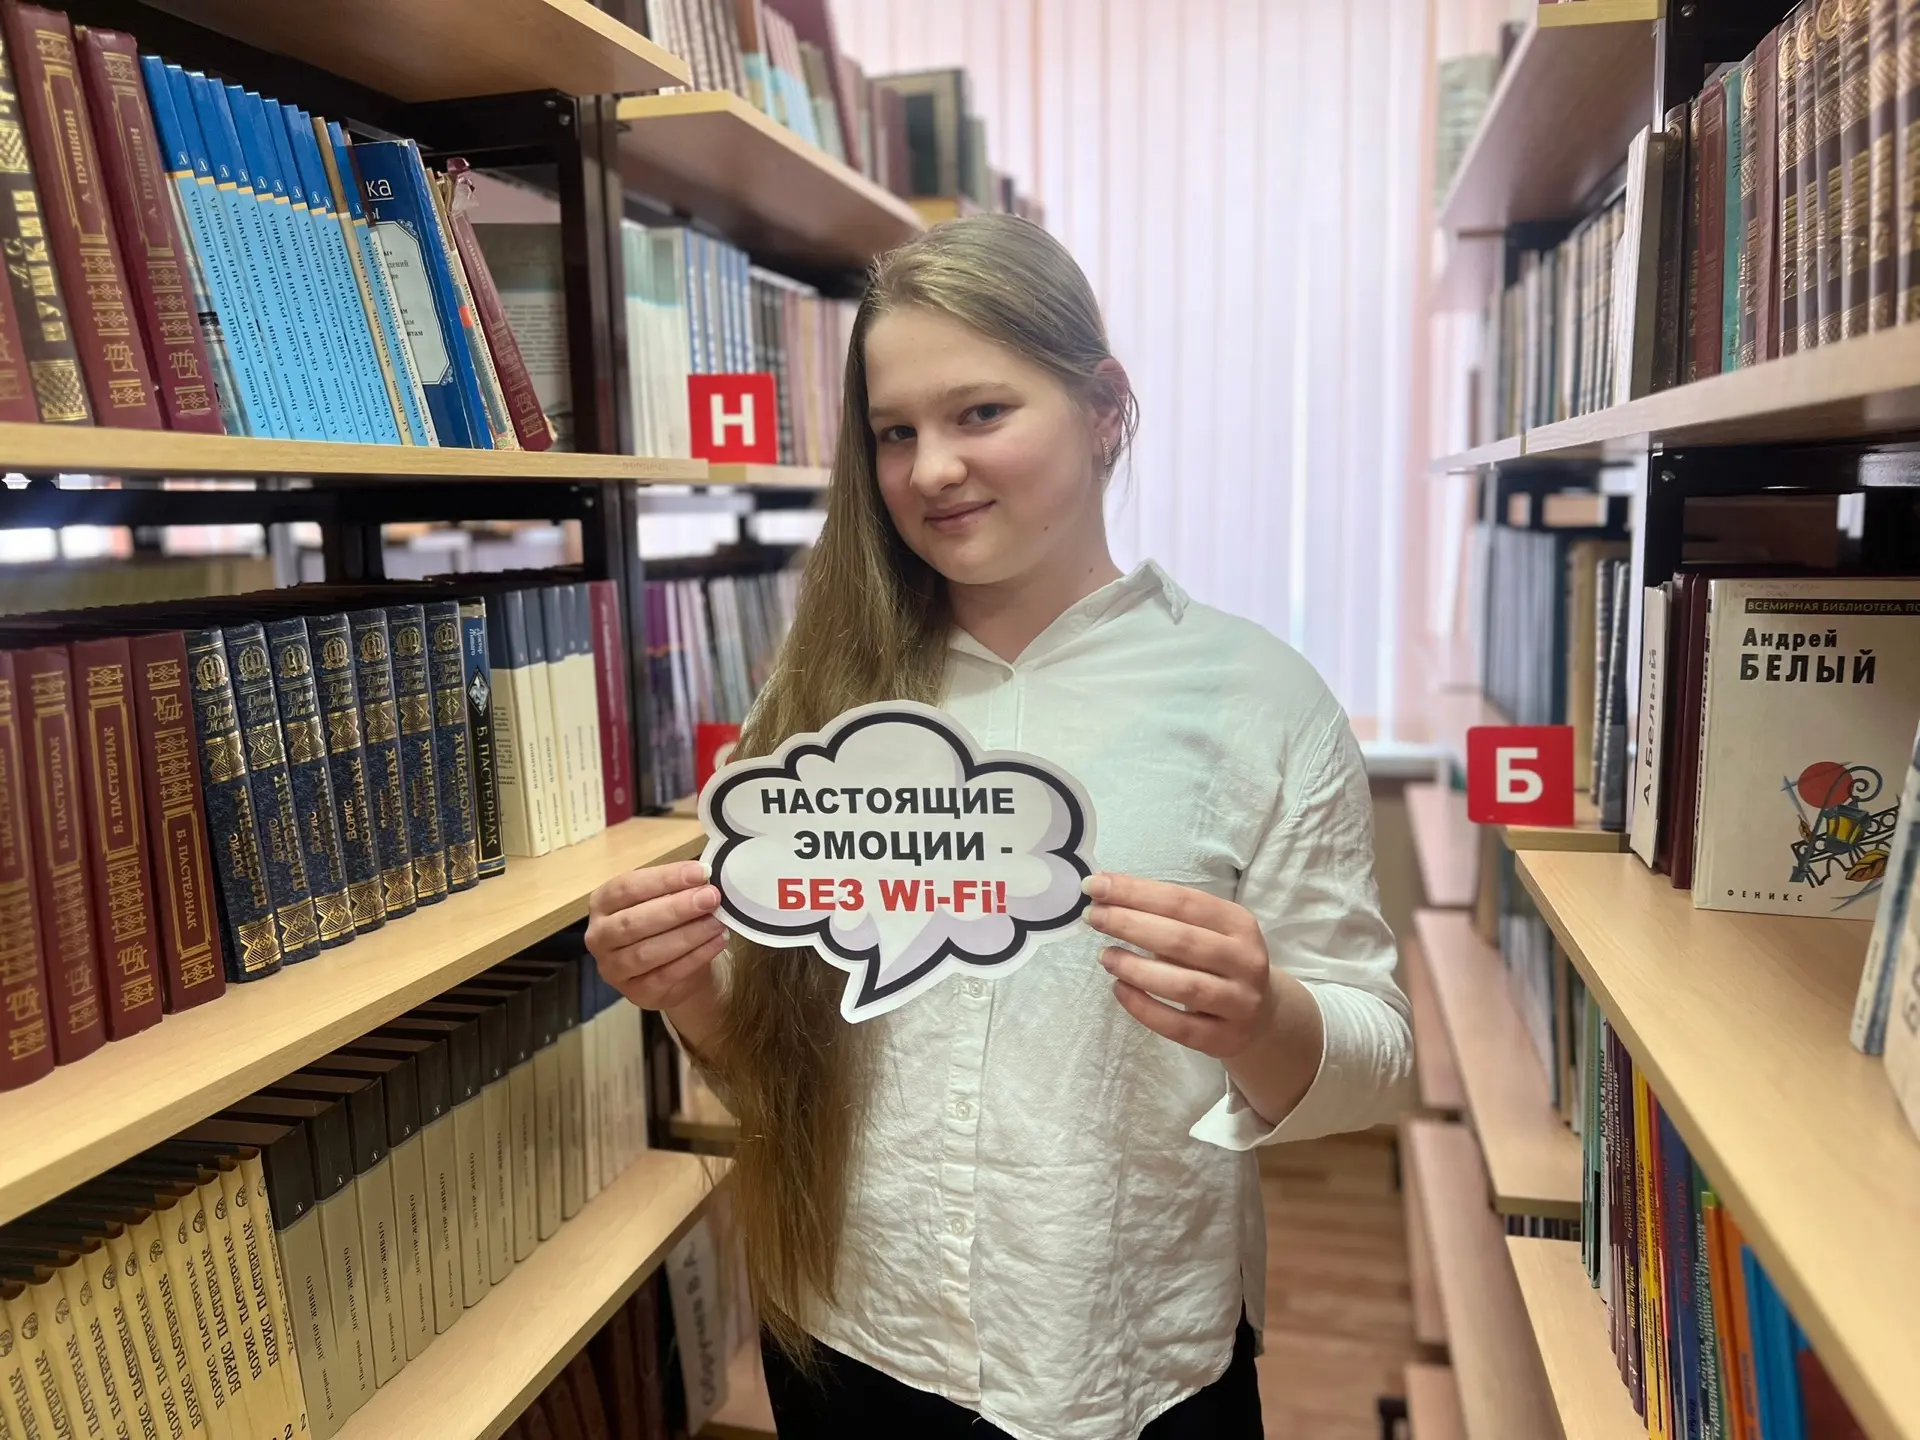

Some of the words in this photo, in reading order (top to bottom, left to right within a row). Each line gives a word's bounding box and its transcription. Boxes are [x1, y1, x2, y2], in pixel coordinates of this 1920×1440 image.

[63, 108, 89, 186] ПУШКИН
[131, 126, 155, 199] ПУШКИН
[190, 191, 212, 250] ЛЮДМИЛА
[210, 197, 231, 255] ЛЮДМИЛА
[232, 203, 252, 260] ЛЮДМИЛА
[250, 206, 271, 263] ЛЮДМИЛА
[268, 213, 289, 268] ЛЮДМИЛА
[12, 189, 68, 342] ПУШКИН
[212, 265, 229, 308] РУСЛАН
[231, 270, 248, 312] РУСЛАН
[252, 274, 269, 316] РУСЛАН
[271, 277, 287, 317] РУСЛАН
[288, 282, 304, 322] РУСЛАН
[228, 316, 245, 360] СКАЗКИ
[247, 322, 263, 363] СКАЗКИ
[268, 325, 283, 366] СКАЗКИ
[285, 327, 301, 366] СКАЗКИ
[302, 331, 317, 370] СКАЗКИ
[244, 367, 259, 405] Пушкин
[263, 370, 277, 408] Пушкин
[283, 373, 297, 409] Пушкин
[301, 373, 314, 410] Пушкин
[317, 377, 330, 413] Пушкин
[710, 393, 756, 446] Н
[1747, 600, 1818, 612] ВСЕМИРНАЯ
[1822, 601, 1901, 613] БИБЛИОТЕКА
[1742, 628, 1838, 651] Андрей
[1740, 648, 1876, 684] БЕЛЫЙ
[477, 726, 489, 741] Б.
[49, 736, 69, 825] ПАСТЕРНАК
[104, 727, 123, 810] ПАСТЕРНАК
[419, 739, 440, 843] ПАСТЕРНАК
[454, 731, 472, 832] ПАСТЕРНАК
[1495, 746, 1544, 804] Б
[344, 799, 357, 841] БОРИС
[386, 747, 407, 854] ПАСТЕРНАК
[479, 744, 497, 847] ПАСТЕРНАК
[760, 787, 1015, 820] НАСТОЯЩИЕ
[113, 813, 124, 834] Б.
[176, 828, 187, 845] Б.
[274, 772, 306, 891] ПАСТЕРНАК
[793, 830, 986, 866] ЭМОЦИИ
[177, 849, 198, 930] ПАСТЕРНАК
[778, 878, 865, 911] БЕЗ
[878, 879, 1007, 915] Wi-Fi!
[1727, 889, 1803, 902] ФЕНИКС
[243, 1218, 266, 1310] ПАСТЕРНАК
[343, 1247, 353, 1289] ЖИВАГО
[378, 1221, 386, 1263] ЖИВАГО
[186, 1256, 211, 1351] ПАСТЕРНАК
[202, 1244, 227, 1338] ПАСТЕРНАК
[224, 1231, 248, 1324] ПАСТЕРНАК
[306, 1275, 316, 1319] ЖИВАГО
[136, 1287, 166, 1384] ПАСТЕРНАК
[159, 1274, 186, 1371] ПАСТЕРНАК
[348, 1294, 358, 1329] ДОКТОР
[113, 1299, 144, 1401] ПАСТЕРНАК
[243, 1327, 261, 1379] БОРИС
[260, 1313, 278, 1366] БОРИС
[312, 1323, 324, 1359] ДОКТОР
[66, 1333, 100, 1438] ПАСТЕРНАК
[90, 1317, 121, 1420] ПАСТЕРНАК
[206, 1354, 224, 1409] БОРИС
[220, 1341, 241, 1394] БОРИС
[322, 1368, 332, 1409] Пастернак
[161, 1386, 182, 1440] БОРИС
[181, 1373, 201, 1428] БОРИС
